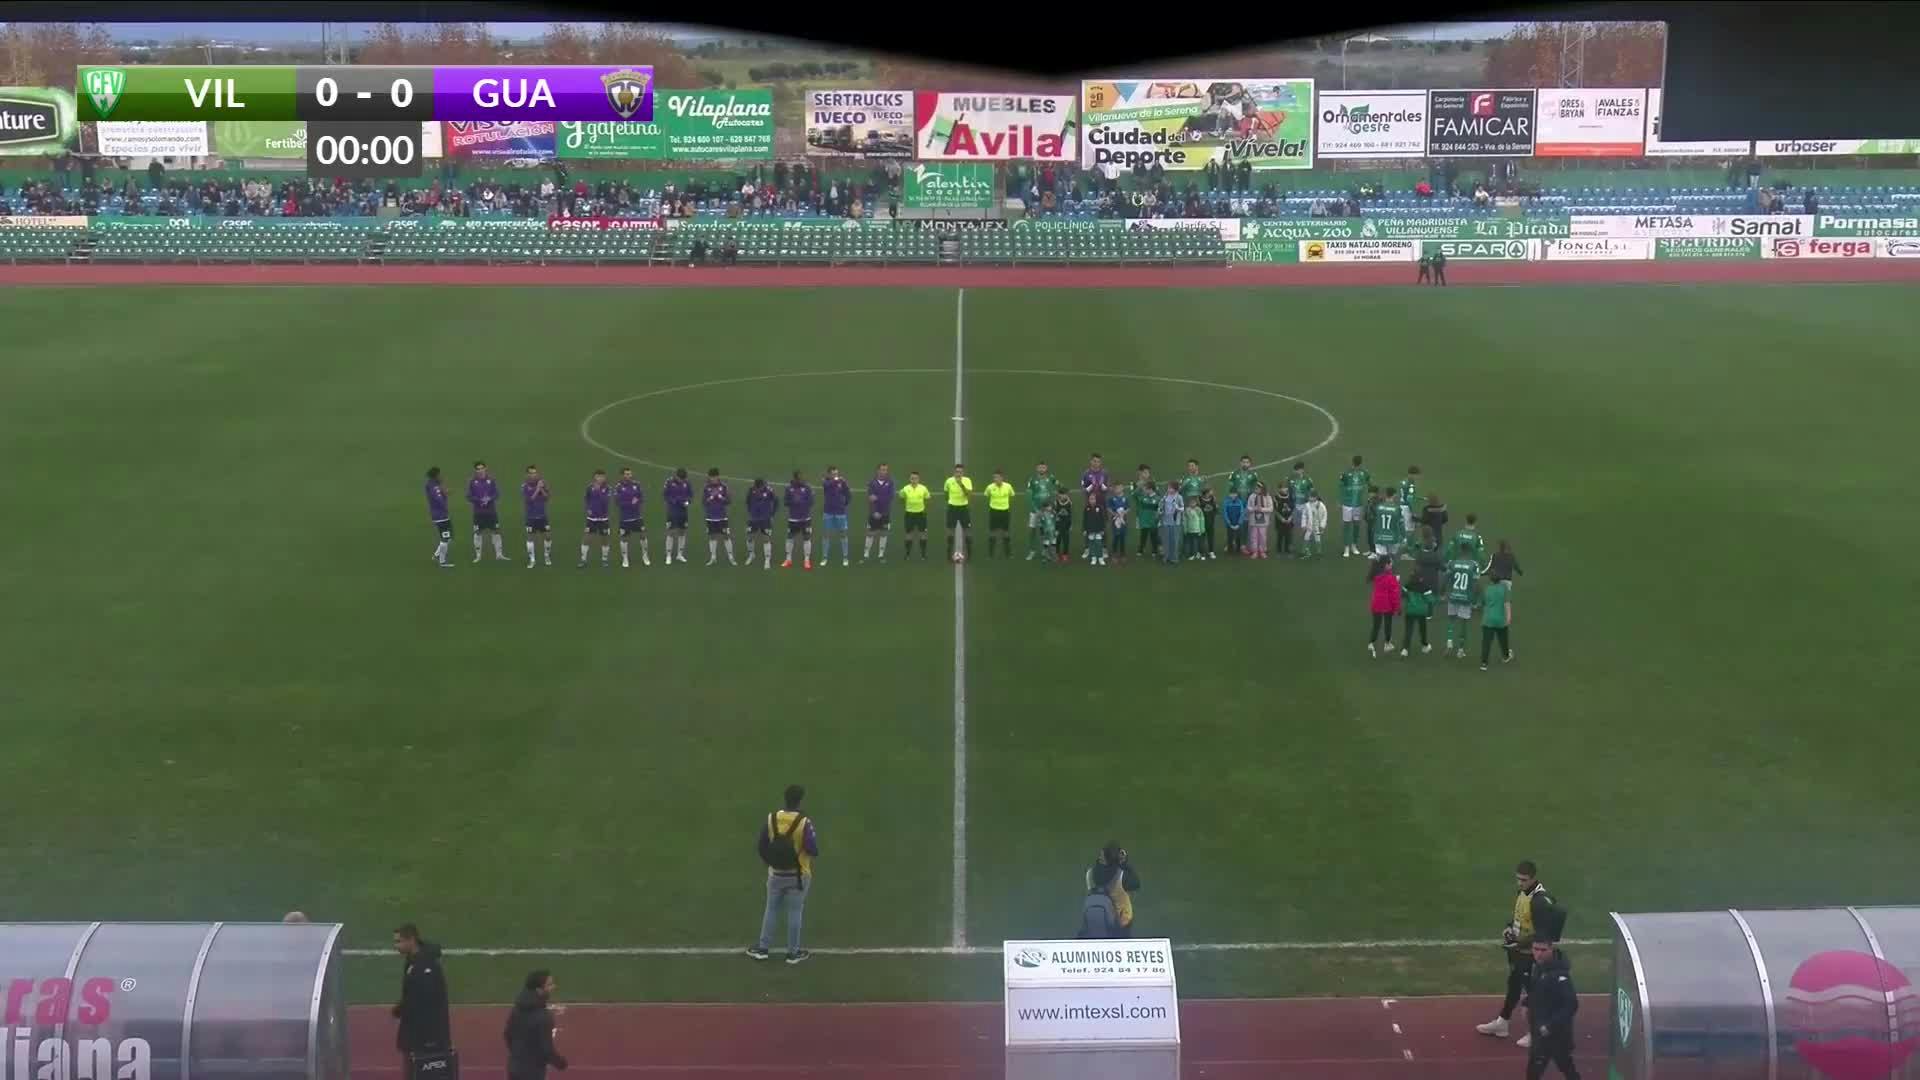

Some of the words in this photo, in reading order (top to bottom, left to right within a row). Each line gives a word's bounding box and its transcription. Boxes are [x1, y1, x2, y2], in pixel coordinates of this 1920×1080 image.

[815, 94, 903, 106] SERTRUCKS
[953, 97, 1056, 113] MUEBLES
[1598, 98, 1633, 107] AVALES
[668, 96, 771, 126] Vilaplana
[815, 112, 866, 124] IVECO
[1088, 111, 1137, 122] Villanueva
[1140, 108, 1152, 118] de
[1164, 106, 1198, 116] Serena
[1323, 109, 1422, 123] Ornamentales
[1560, 109, 1585, 118] BRYAN
[1597, 108, 1640, 117] FIANZAS
[716, 117, 764, 128] Autocares
[1434, 117, 1529, 136] FAMICAR
[944, 113, 1062, 157] Ávila
[1088, 126, 1167, 145] Ciudad
[1168, 133, 1185, 141] del
[152, 145, 175, 153] para
[1775, 140, 1837, 153] urbaser
[1095, 148, 1186, 168] Deporte
[1378, 218, 1403, 226] PEÑA
[1406, 218, 1467, 226] MADRIDISTA
[1475, 220, 1498, 235] La
[1507, 219, 1568, 237] Picada
[1634, 216, 1693, 228] METASA
[1730, 218, 1803, 236] Samat
[1820, 215, 1918, 229] Pormasa
[1263, 228, 1311, 239] ACQUA
[1322, 228, 1352, 238] ZOO
[1659, 237, 1755, 248] SEGURDON
[1809, 239, 1871, 257] ferga
[1440, 243, 1505, 258] SPAR
[1381, 514, 1392, 530] 17
[1453, 571, 1469, 590] 20
[1051, 951, 1123, 964] ALUMINIOS
[1127, 950, 1165, 963] REYES
[1018, 1003, 1167, 1021] www.imtexsl.com
